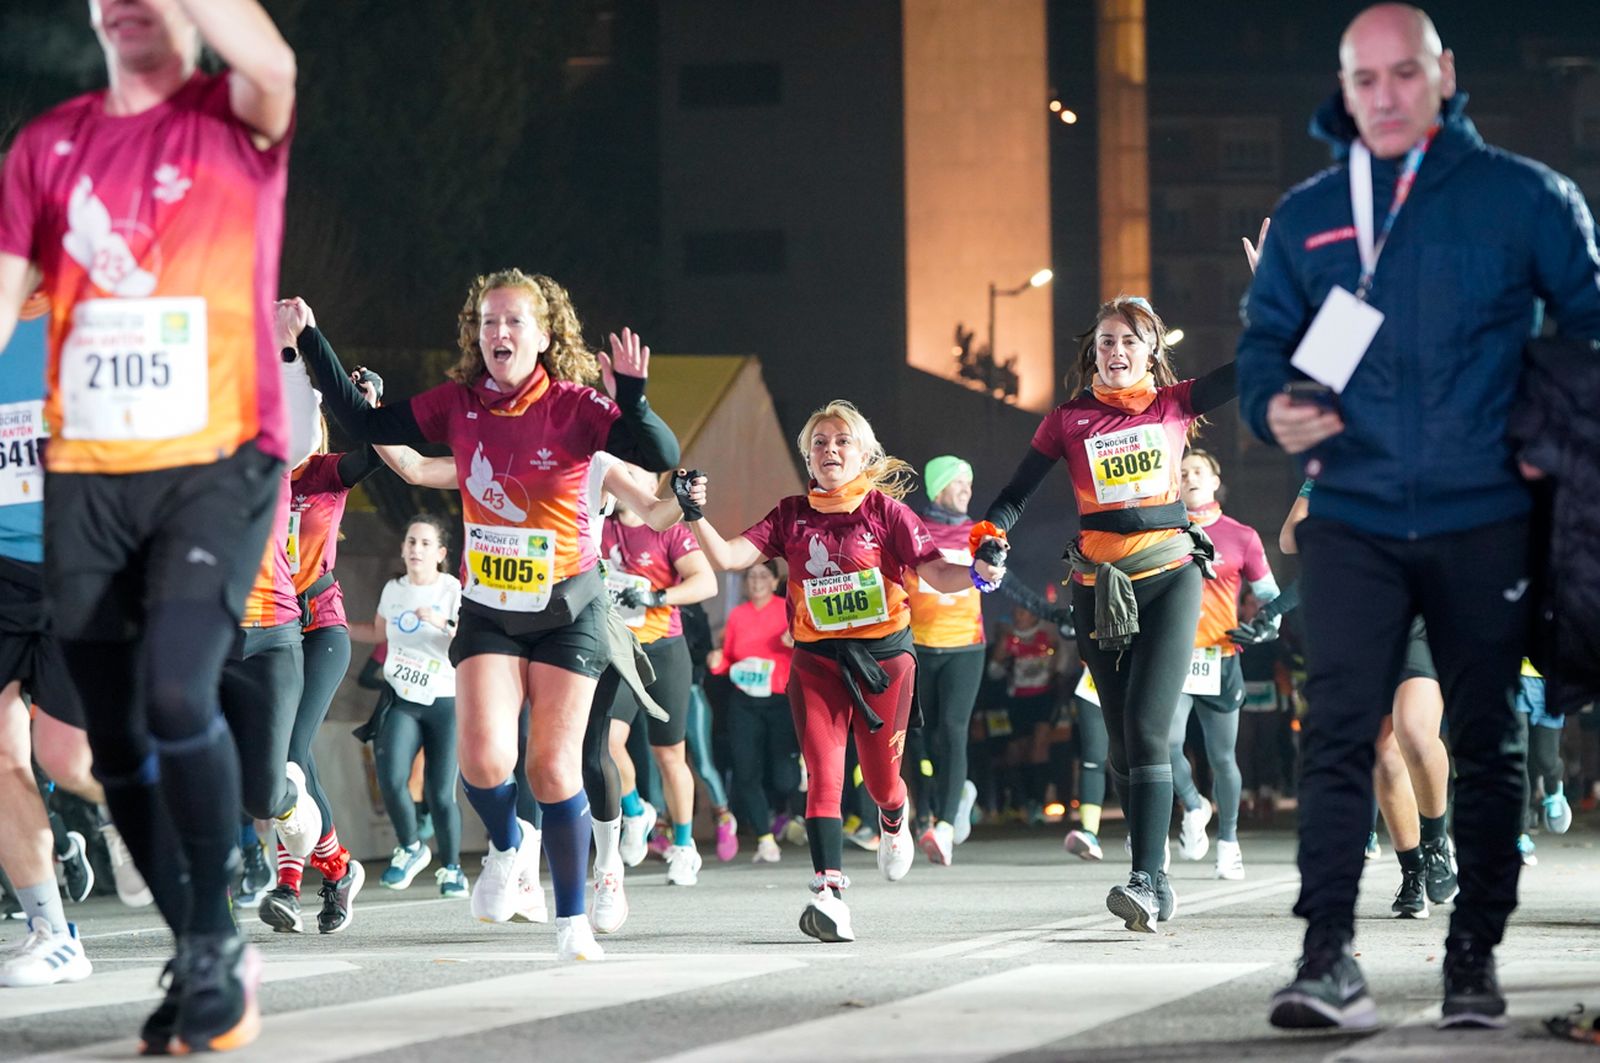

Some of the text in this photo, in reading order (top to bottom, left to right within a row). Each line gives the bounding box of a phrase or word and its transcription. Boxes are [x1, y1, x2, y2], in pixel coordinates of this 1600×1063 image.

[86, 353, 170, 389] 2105
[0, 415, 19, 425] OCHE
[1104, 435, 1138, 448] NOCHE DE
[1097, 448, 1113, 458] SAN
[1100, 449, 1162, 479] 13082
[482, 488, 504, 510] 43
[474, 542, 489, 552] SAN
[484, 534, 519, 546] NOCHE DE
[481, 555, 533, 583] 4105
[819, 575, 851, 586] NOCHE DE
[811, 587, 827, 597] SAN
[823, 590, 869, 617] 1146
[393, 664, 430, 687] 2388
[1190, 661, 1210, 677] 89
